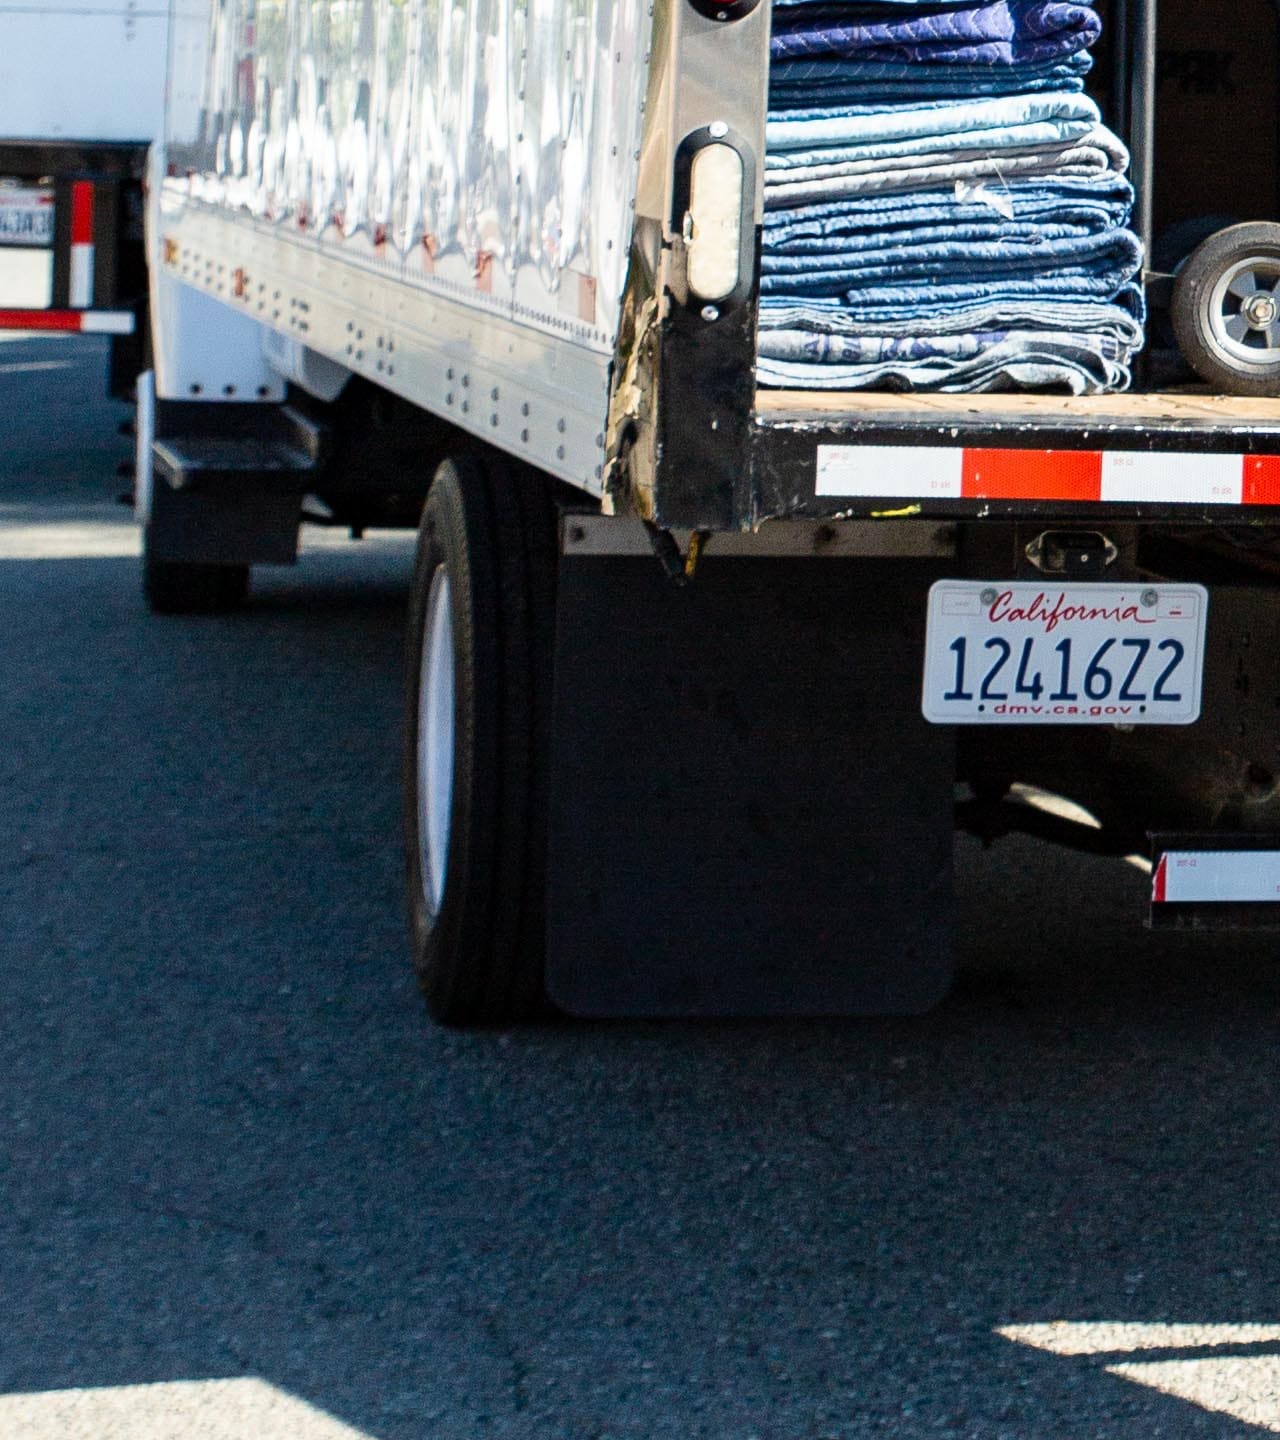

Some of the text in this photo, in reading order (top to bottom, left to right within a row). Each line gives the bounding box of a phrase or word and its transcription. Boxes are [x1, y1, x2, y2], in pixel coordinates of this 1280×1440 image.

[988, 591, 1157, 633] California
[943, 636, 1185, 702] 12416Z2
[993, 703, 1133, 716] dmv.ca.gov
